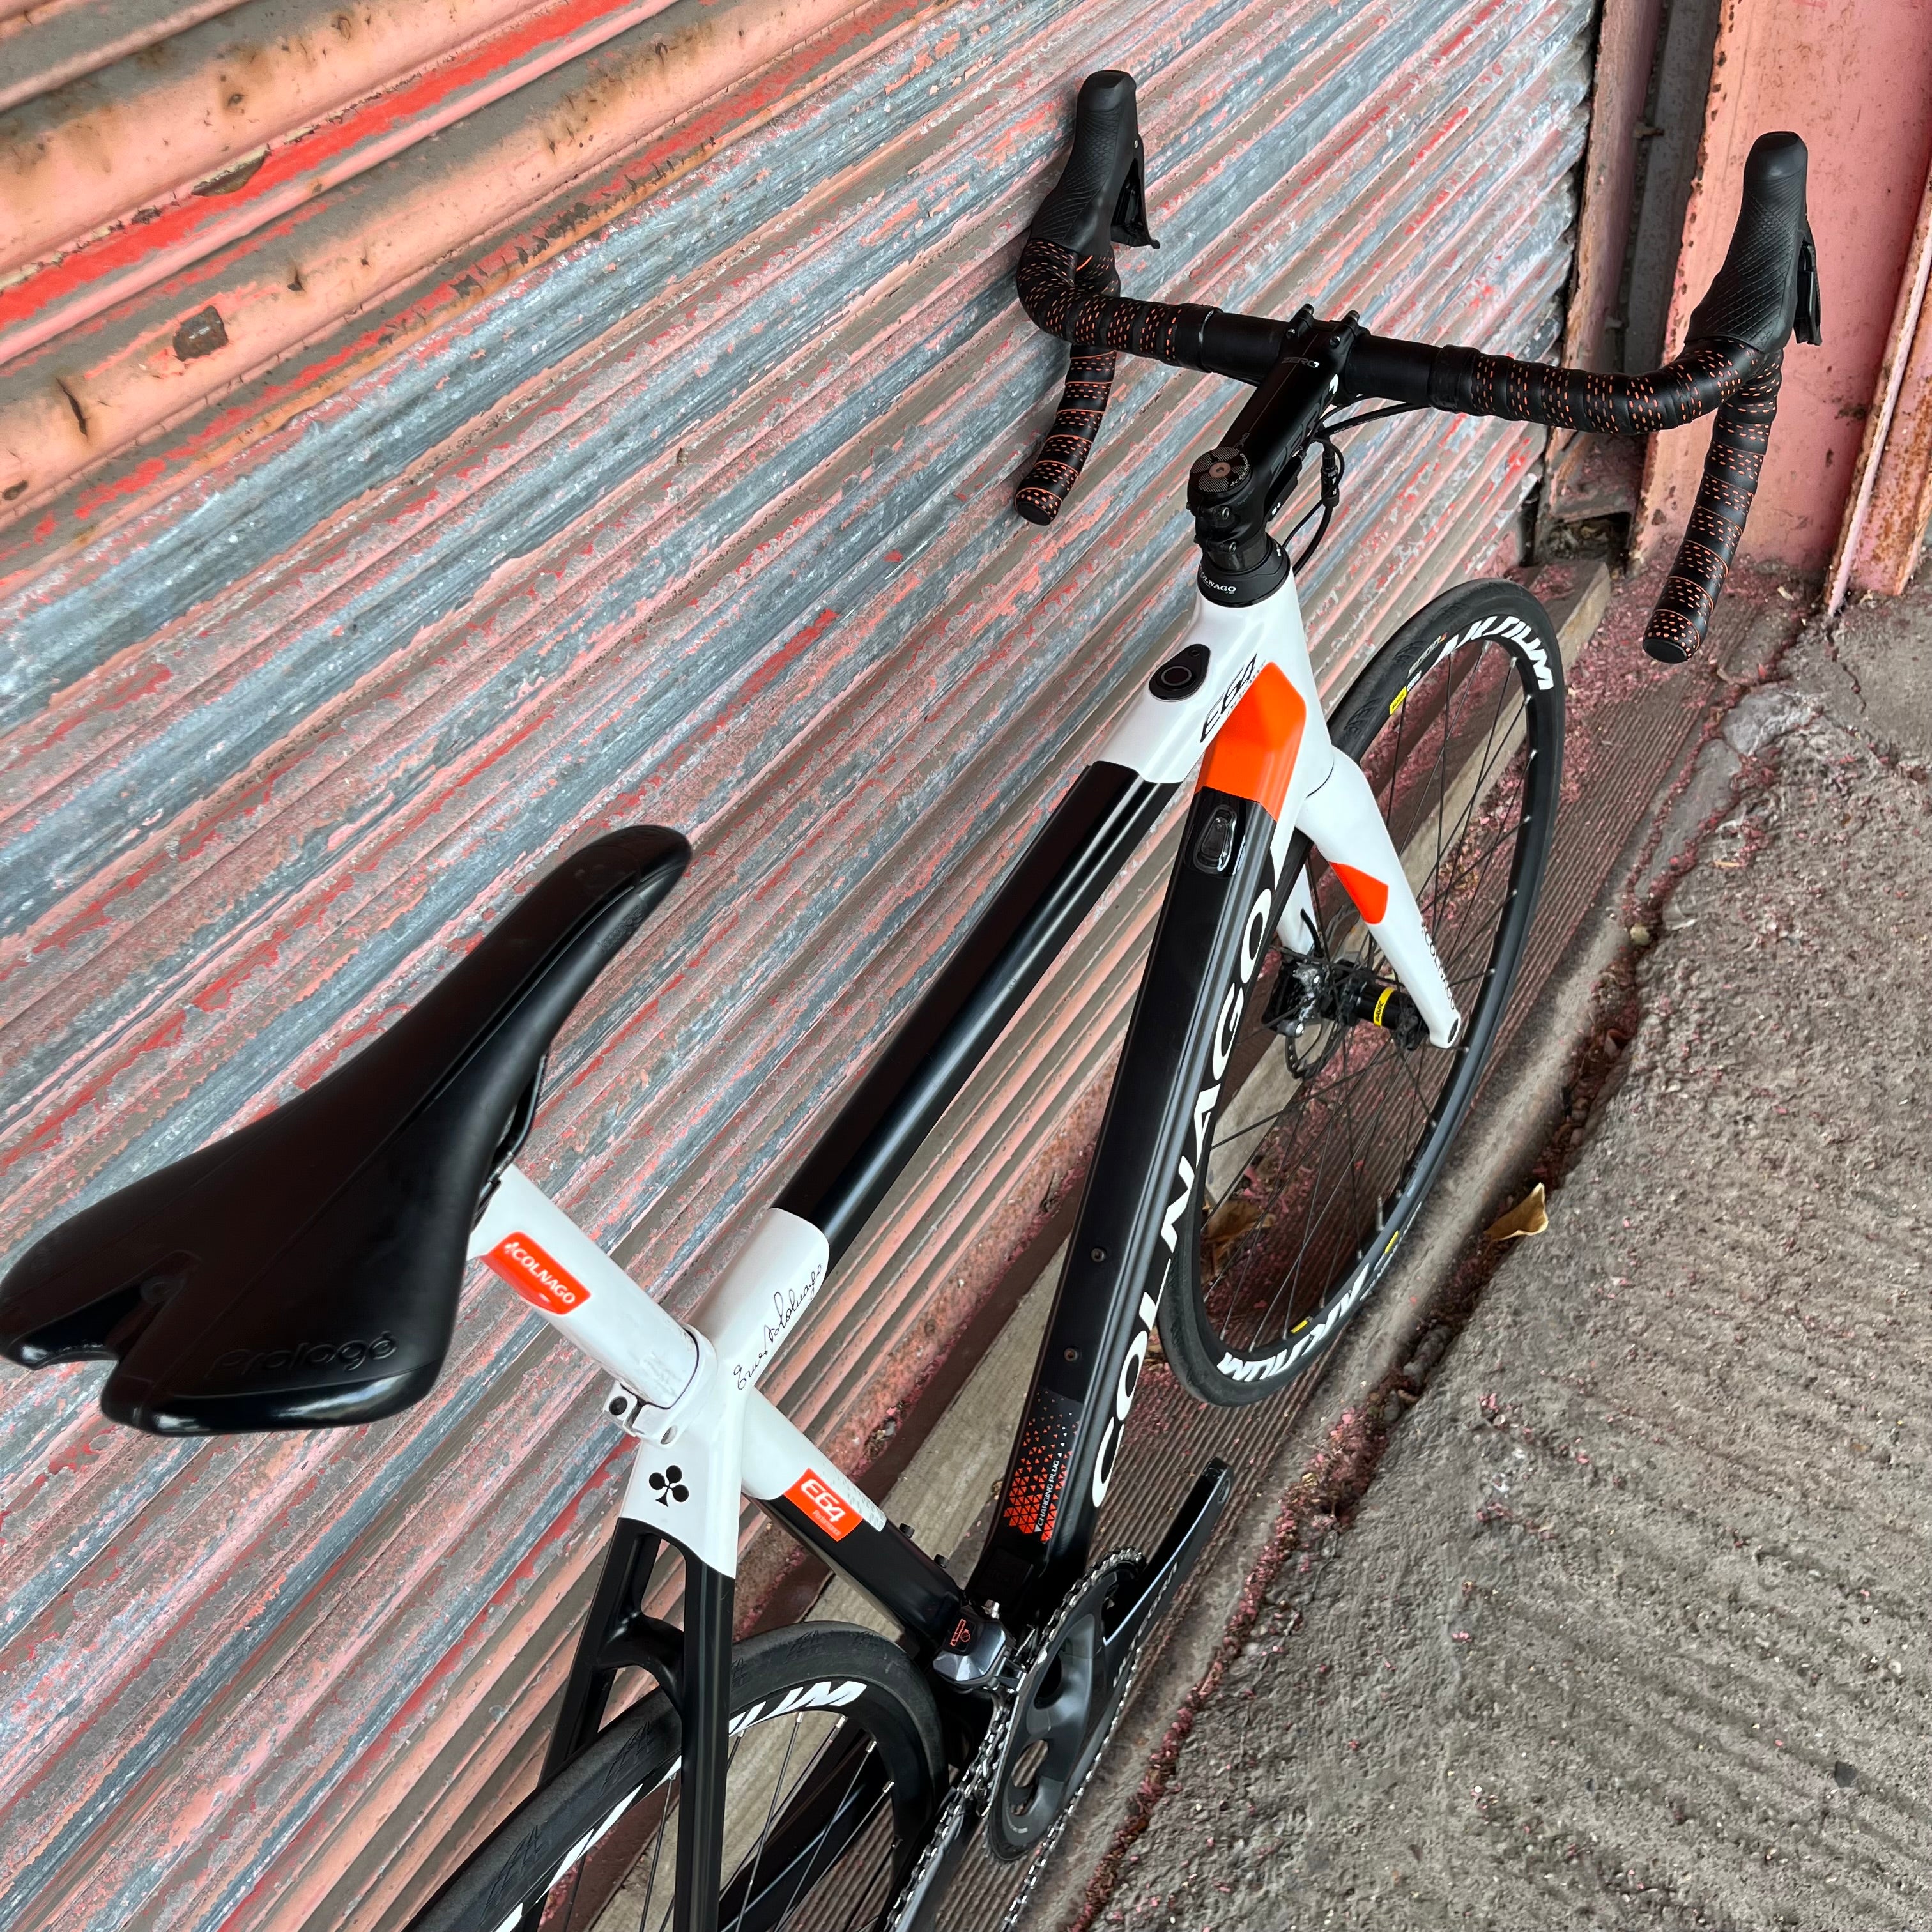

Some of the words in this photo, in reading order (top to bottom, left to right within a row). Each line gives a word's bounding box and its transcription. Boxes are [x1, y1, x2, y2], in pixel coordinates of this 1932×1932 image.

[1200, 652, 1257, 744] E64
[512, 1248, 576, 1304] COLNAGO
[801, 1478, 846, 1522] E64
[1037, 1483, 1054, 1527] CHARGING
[1048, 1459, 1060, 1483] PLUG
